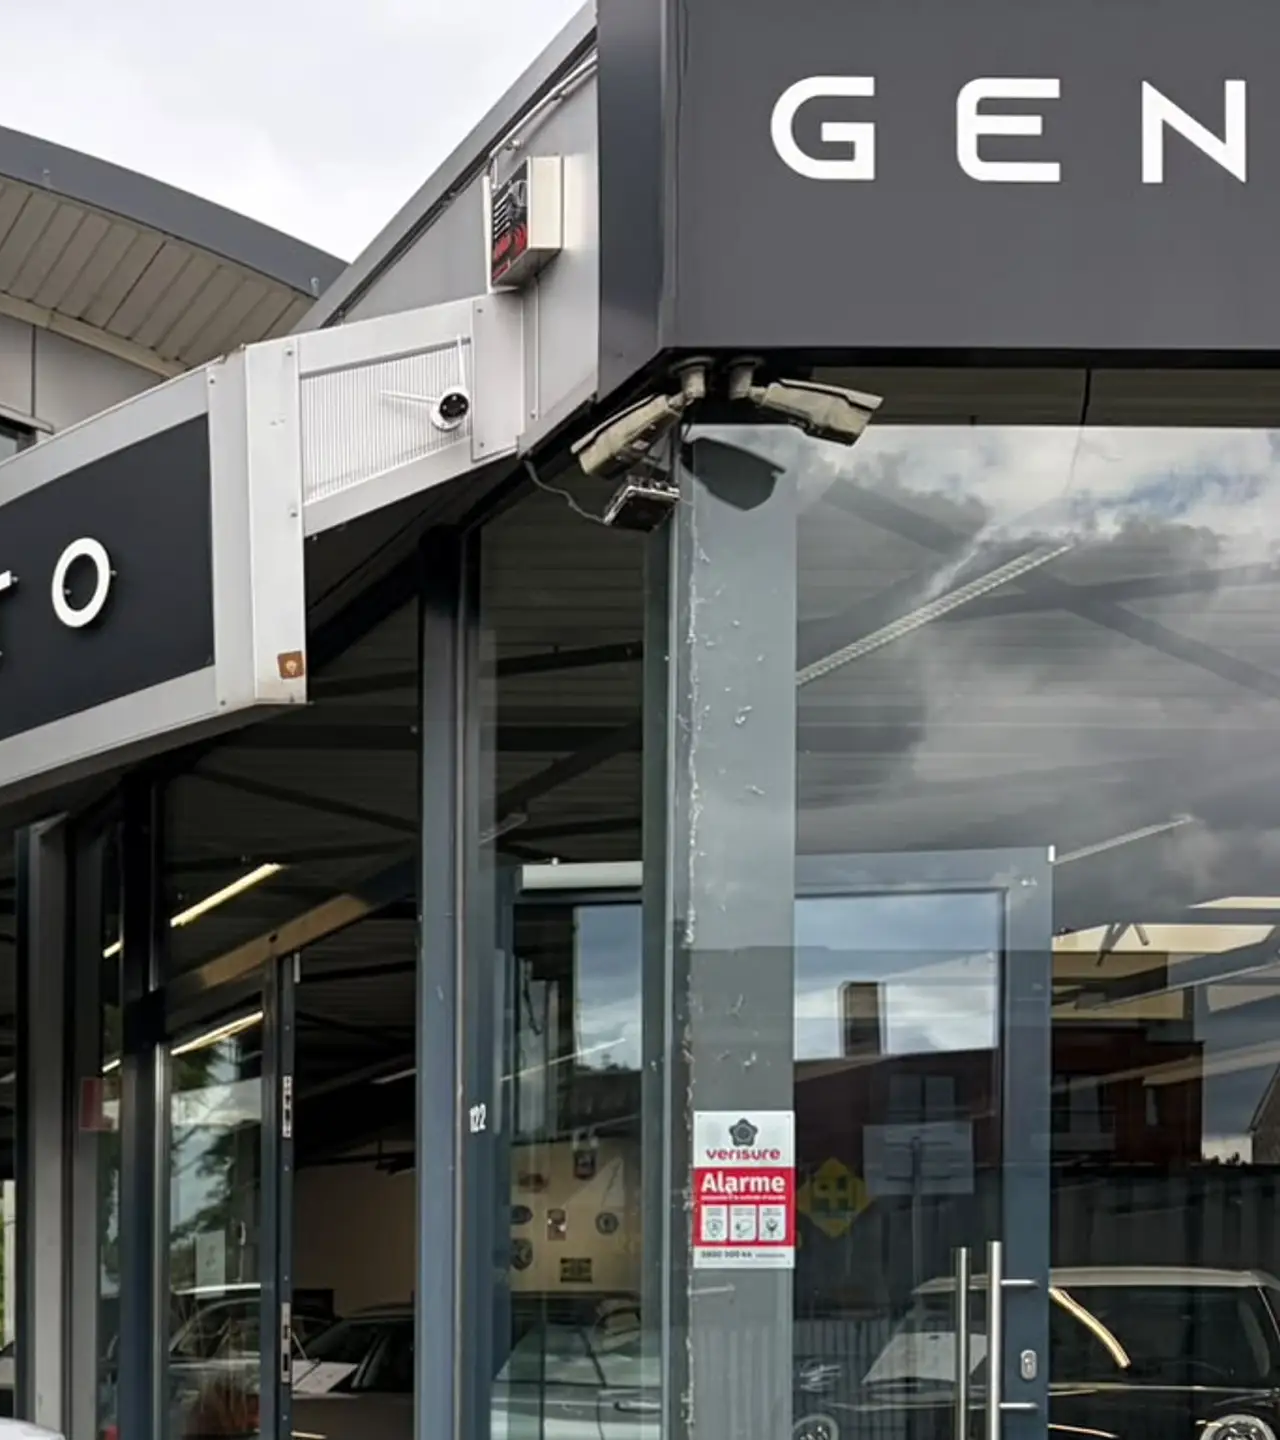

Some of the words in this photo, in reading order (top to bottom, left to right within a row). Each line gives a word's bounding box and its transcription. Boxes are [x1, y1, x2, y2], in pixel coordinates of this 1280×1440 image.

[771, 76, 1246, 183] GEN
[706, 1148, 781, 1161] verisure
[701, 1170, 785, 1193] Alarme
